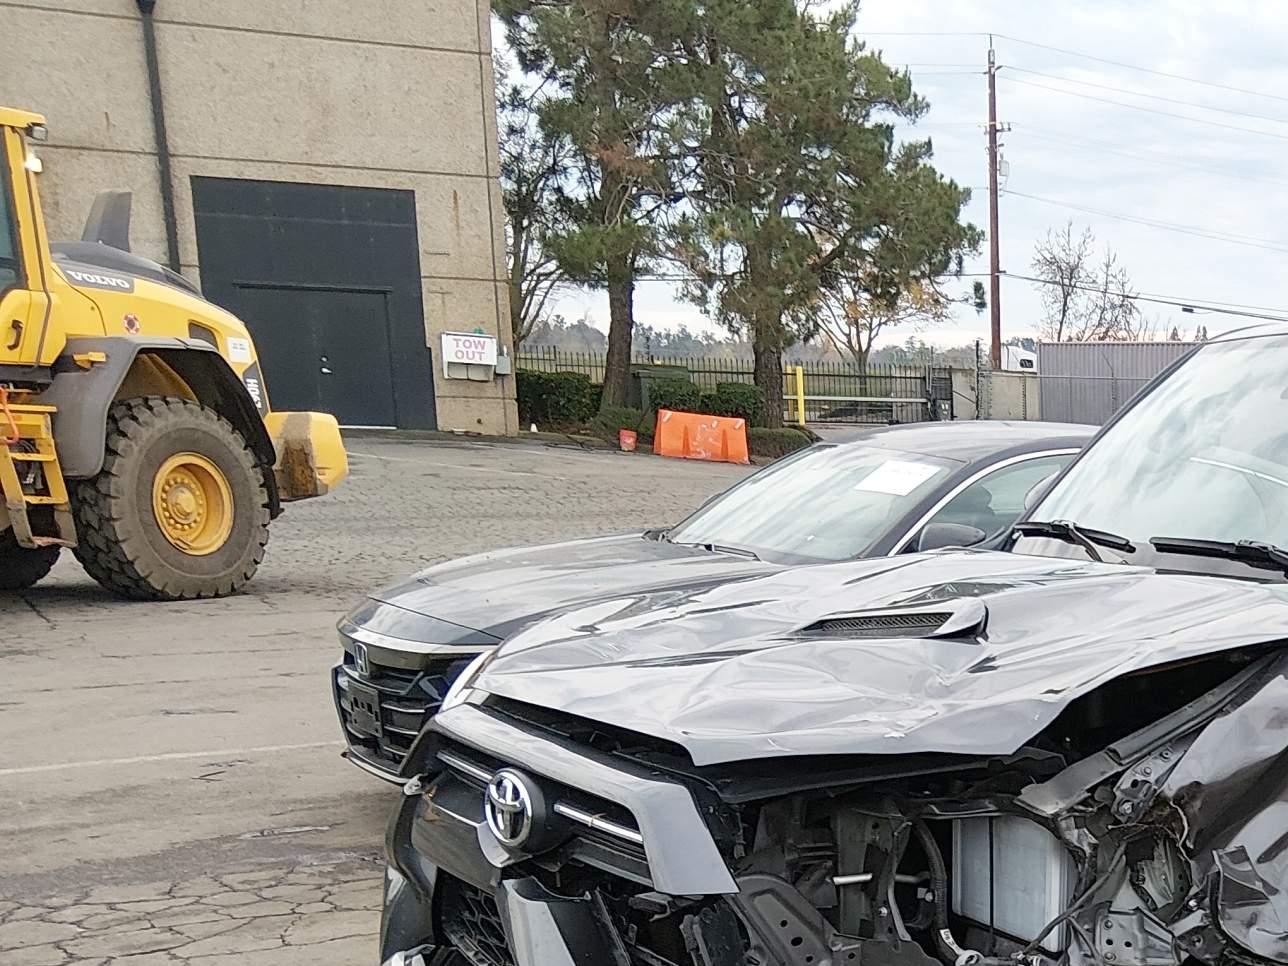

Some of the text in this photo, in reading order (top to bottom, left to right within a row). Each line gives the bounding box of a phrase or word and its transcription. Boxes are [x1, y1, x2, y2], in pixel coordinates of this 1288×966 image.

[65, 270, 131, 289] VOLVO
[453, 338, 486, 350] TOW
[455, 350, 486, 361] OUT
